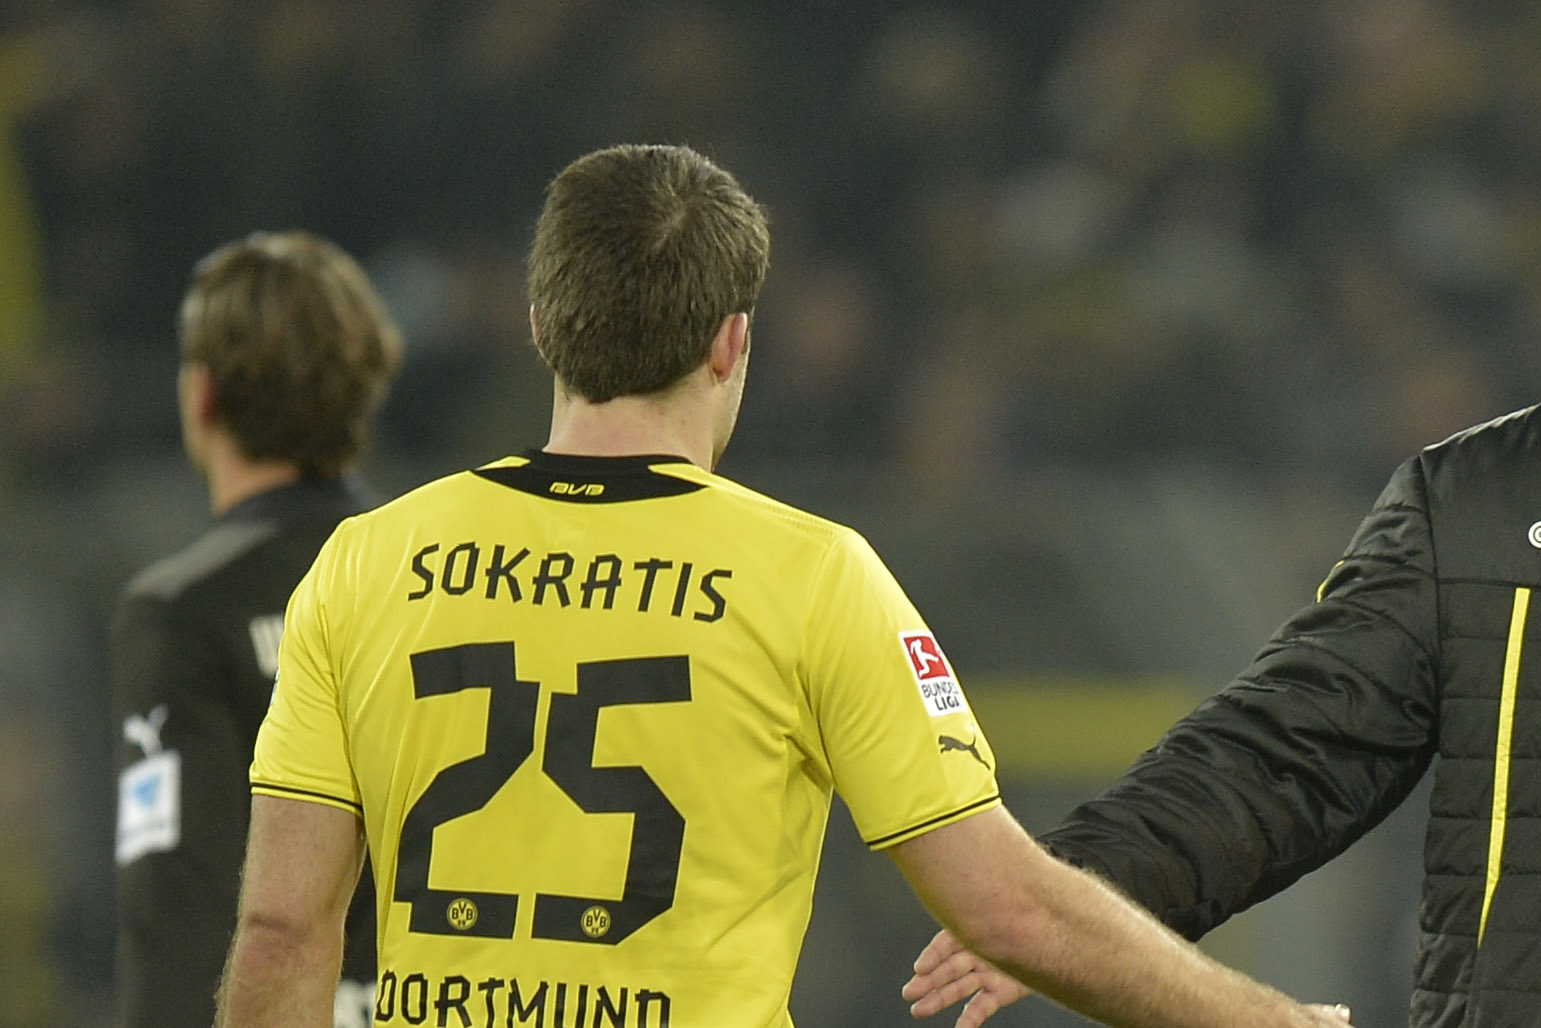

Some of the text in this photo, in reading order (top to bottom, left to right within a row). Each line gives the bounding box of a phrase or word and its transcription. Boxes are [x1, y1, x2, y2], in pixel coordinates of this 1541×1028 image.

[549, 482, 605, 496] BVB
[408, 541, 732, 623] SOKRATIS
[393, 640, 692, 946] 25
